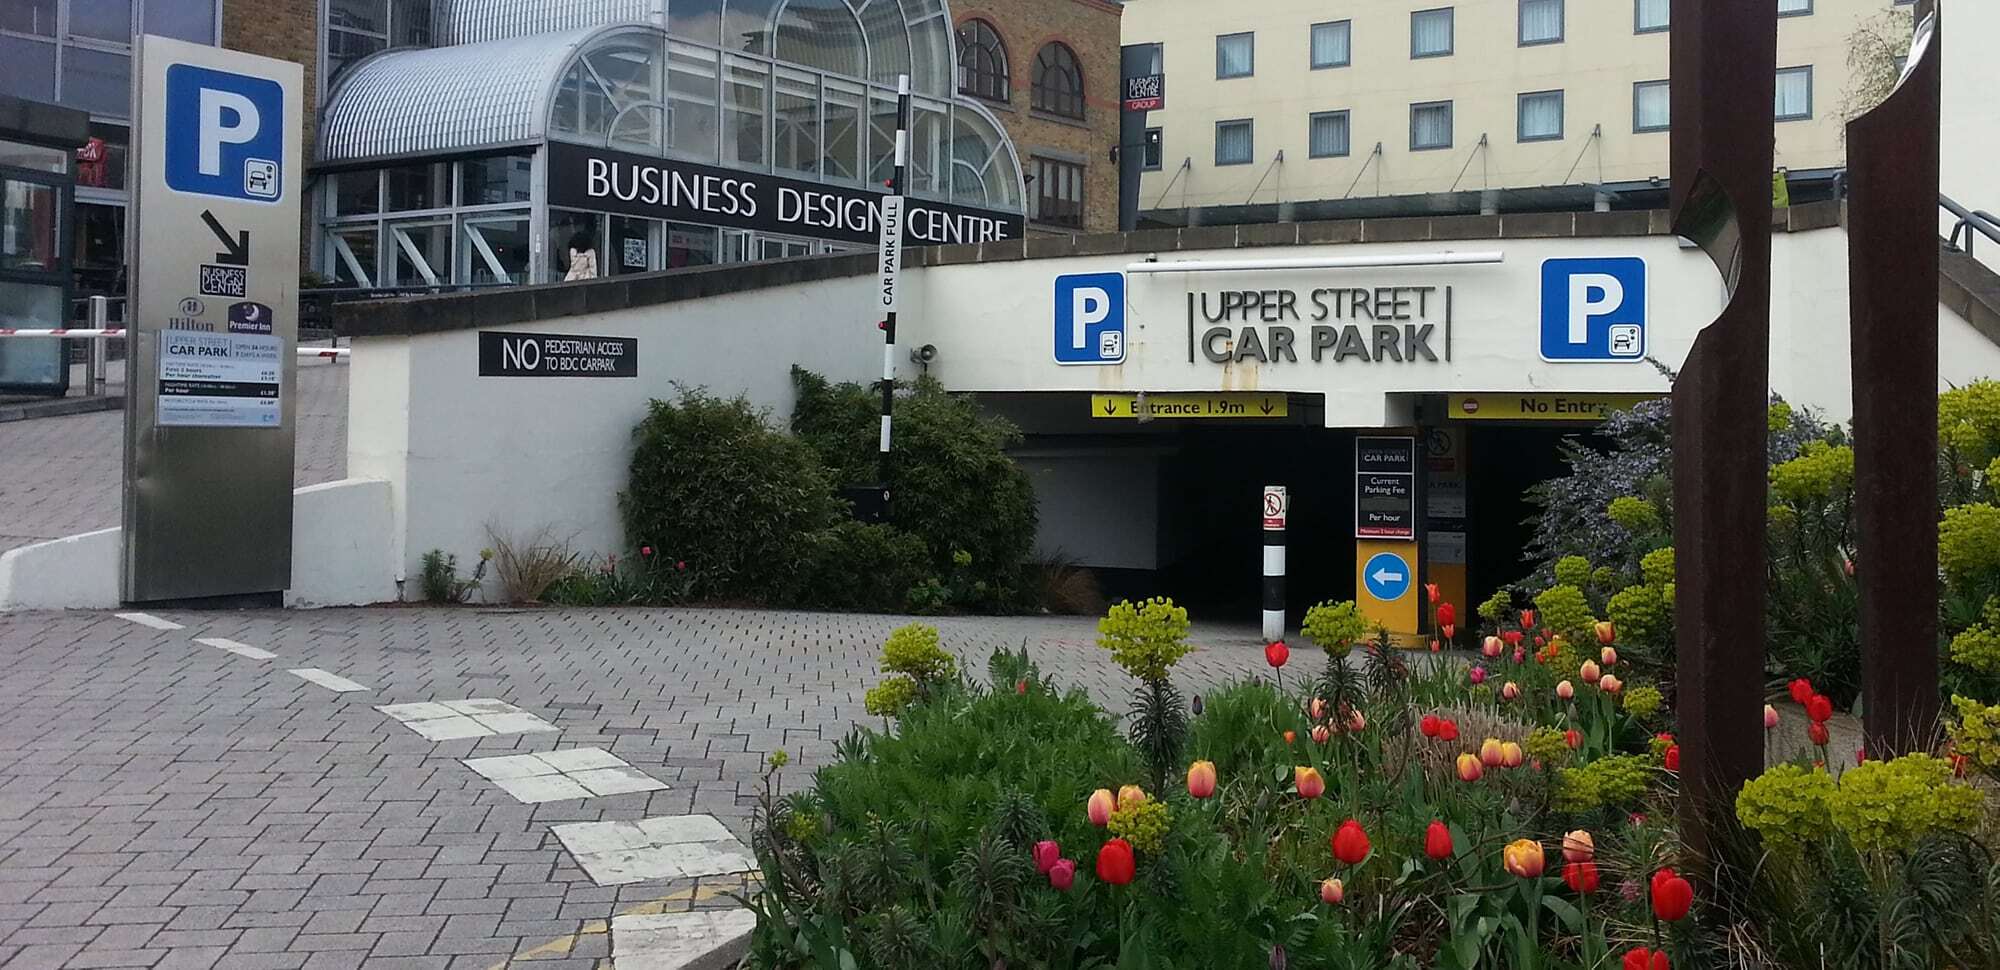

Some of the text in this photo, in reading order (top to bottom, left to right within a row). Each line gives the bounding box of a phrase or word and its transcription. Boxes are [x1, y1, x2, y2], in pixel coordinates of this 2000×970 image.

[199, 87, 260, 176] P
[587, 158, 1008, 244] BUSINESS DESIGN CENTRE
[883, 202, 898, 305] CAR PARK FULL
[202, 267, 244, 279] BUSINESS
[203, 274, 244, 286] DESIGN
[202, 283, 244, 295] CENTRE
[1201, 286, 1436, 323] UPPER STREET
[1568, 274, 1624, 343] P
[169, 317, 214, 331] Hilton
[1073, 287, 1110, 348] P
[229, 321, 270, 331] Premier Inn
[170, 345, 228, 357] CAR PARK
[544, 339, 623, 356] PEDESTRIAN ACCESS
[1201, 324, 1438, 364] CAR PARK
[503, 338, 540, 370] NO
[544, 356, 616, 371] TO BDC CARPARK
[1207, 400, 1245, 414] 1.9m
[1520, 398, 1549, 413] No
[1364, 454, 1406, 462] CAR PARK
[1370, 477, 1399, 485] Current
[1364, 485, 1406, 495] Parking Fee
[1369, 512, 1400, 521] Per hour
